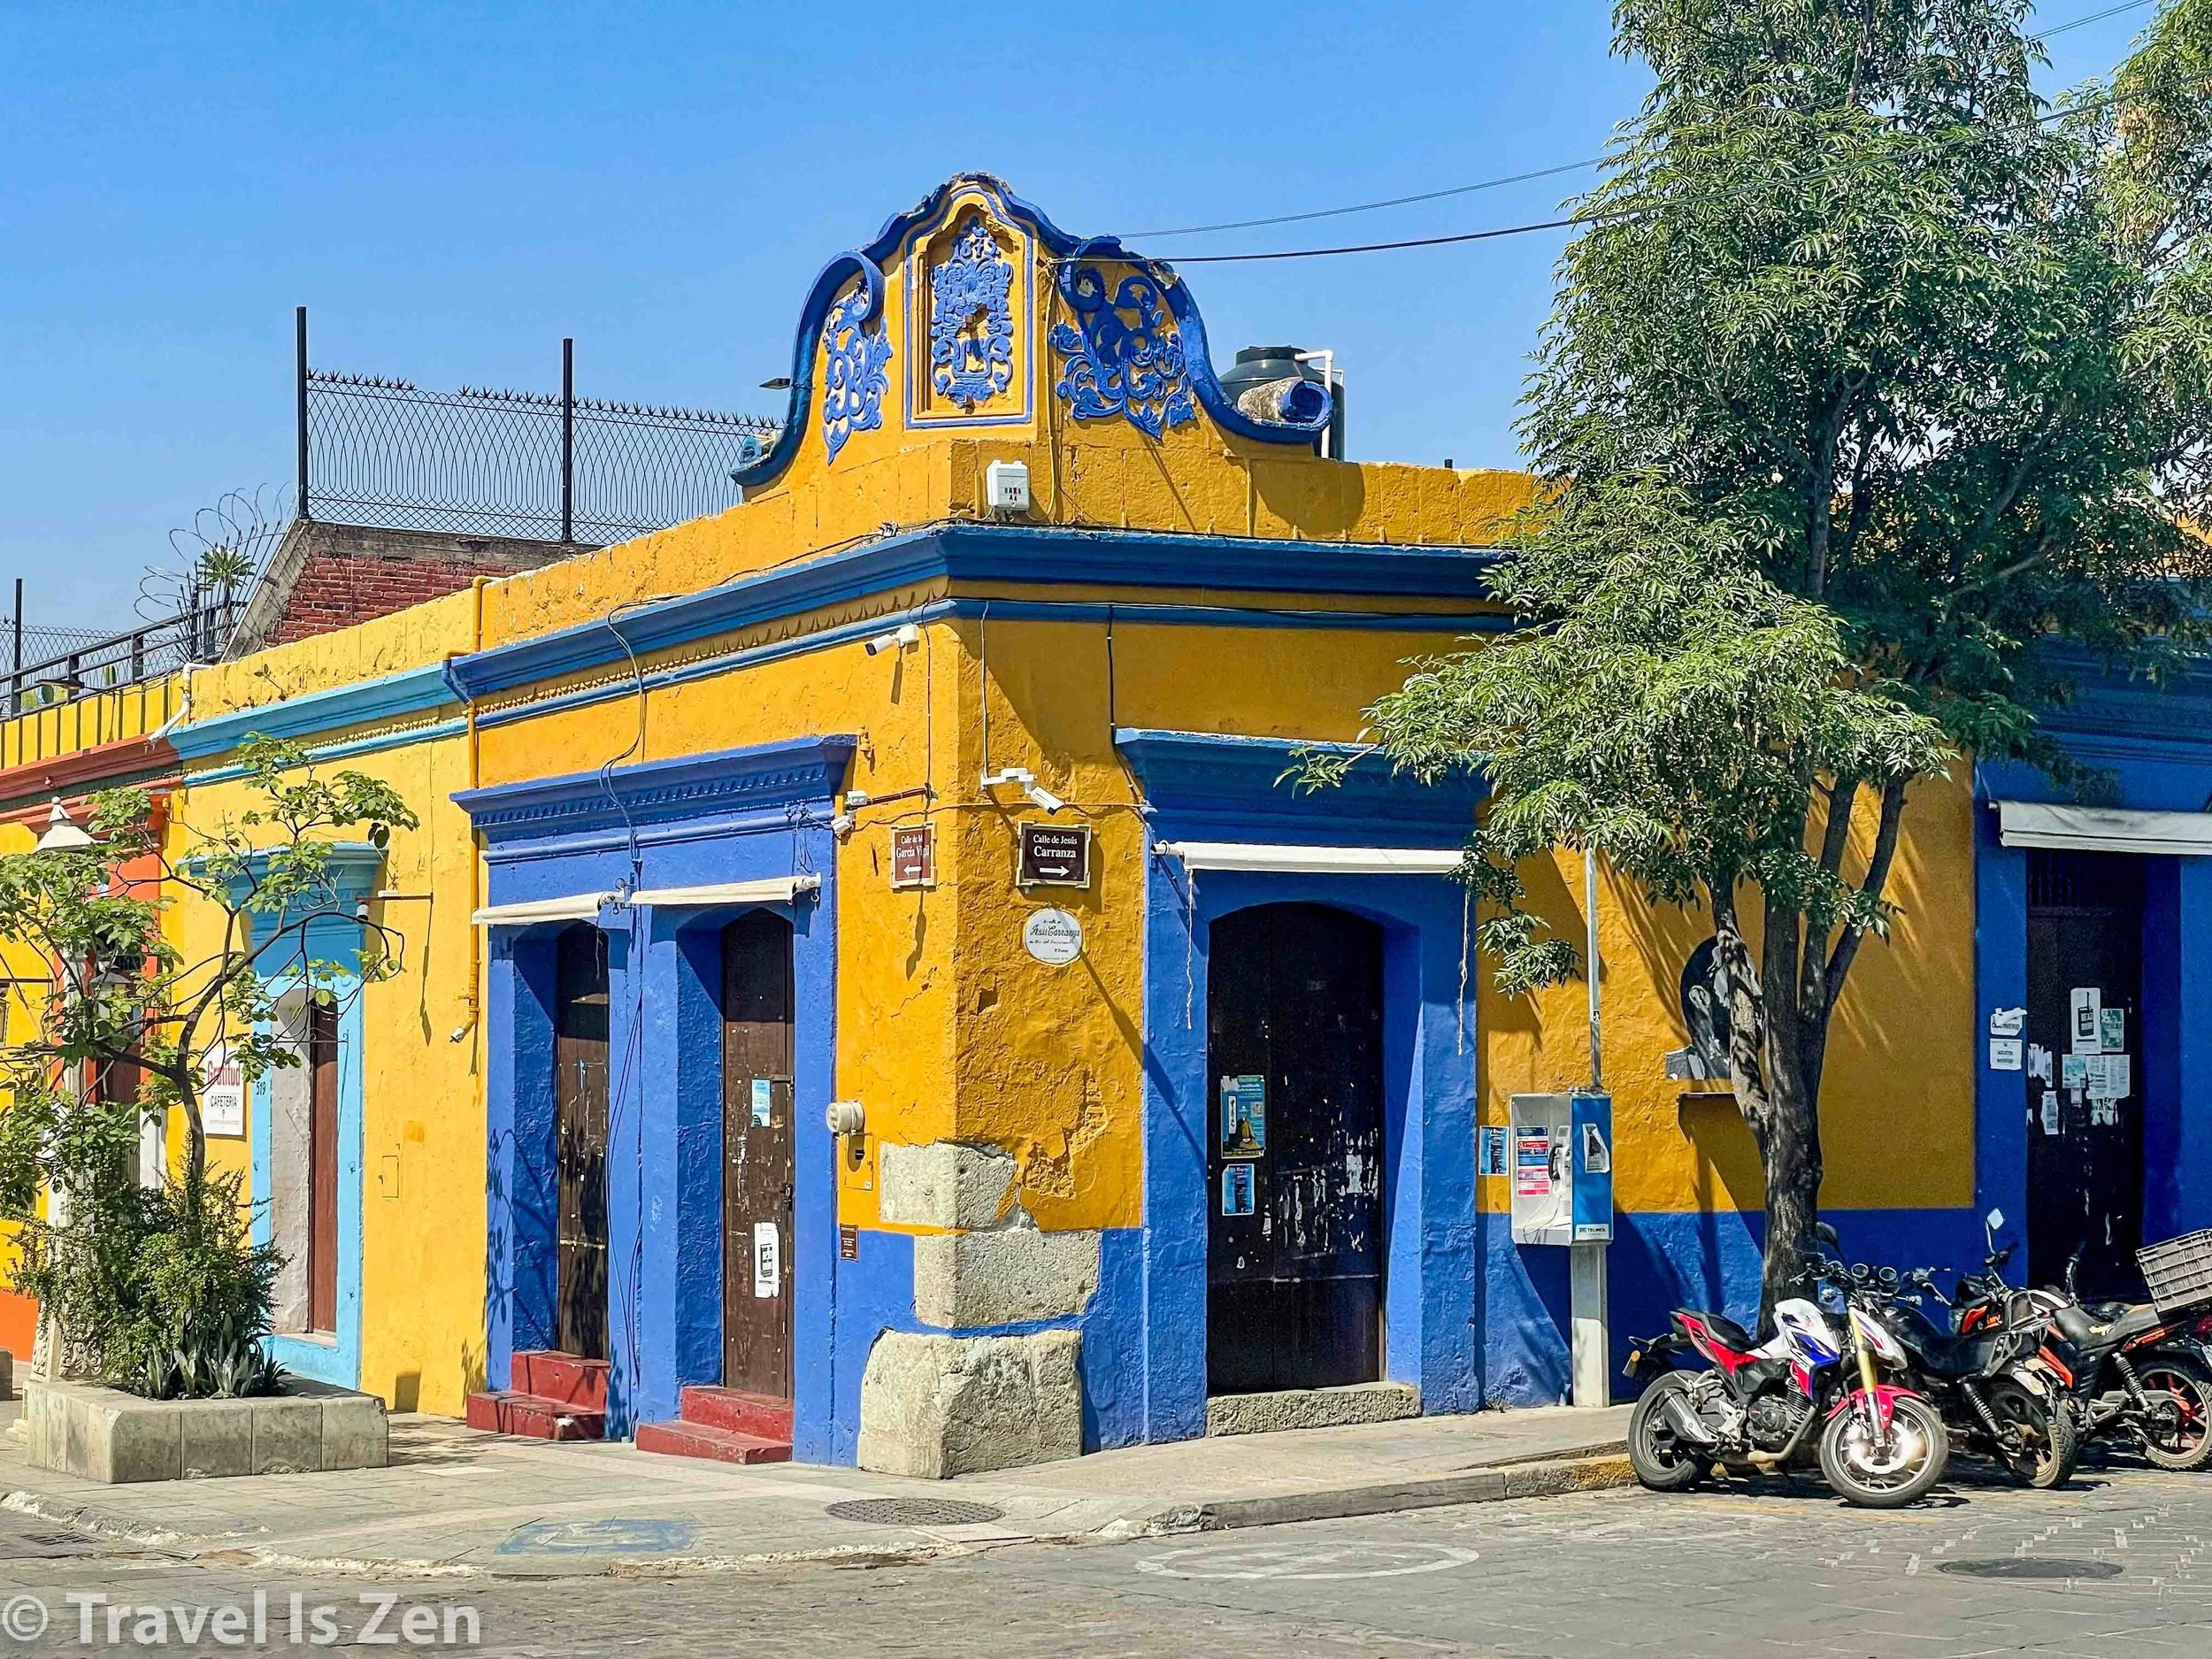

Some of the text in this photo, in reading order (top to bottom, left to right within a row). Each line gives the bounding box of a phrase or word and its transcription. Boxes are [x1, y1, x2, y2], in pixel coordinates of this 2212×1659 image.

[912, 834, 918, 843] de
[1033, 834, 1078, 845] Calle de Jesús
[896, 847, 916, 857] García
[1033, 845, 1077, 858] Carranza
[207, 1060, 241, 1087] Gratitud
[256, 1081, 266, 1095] 519
